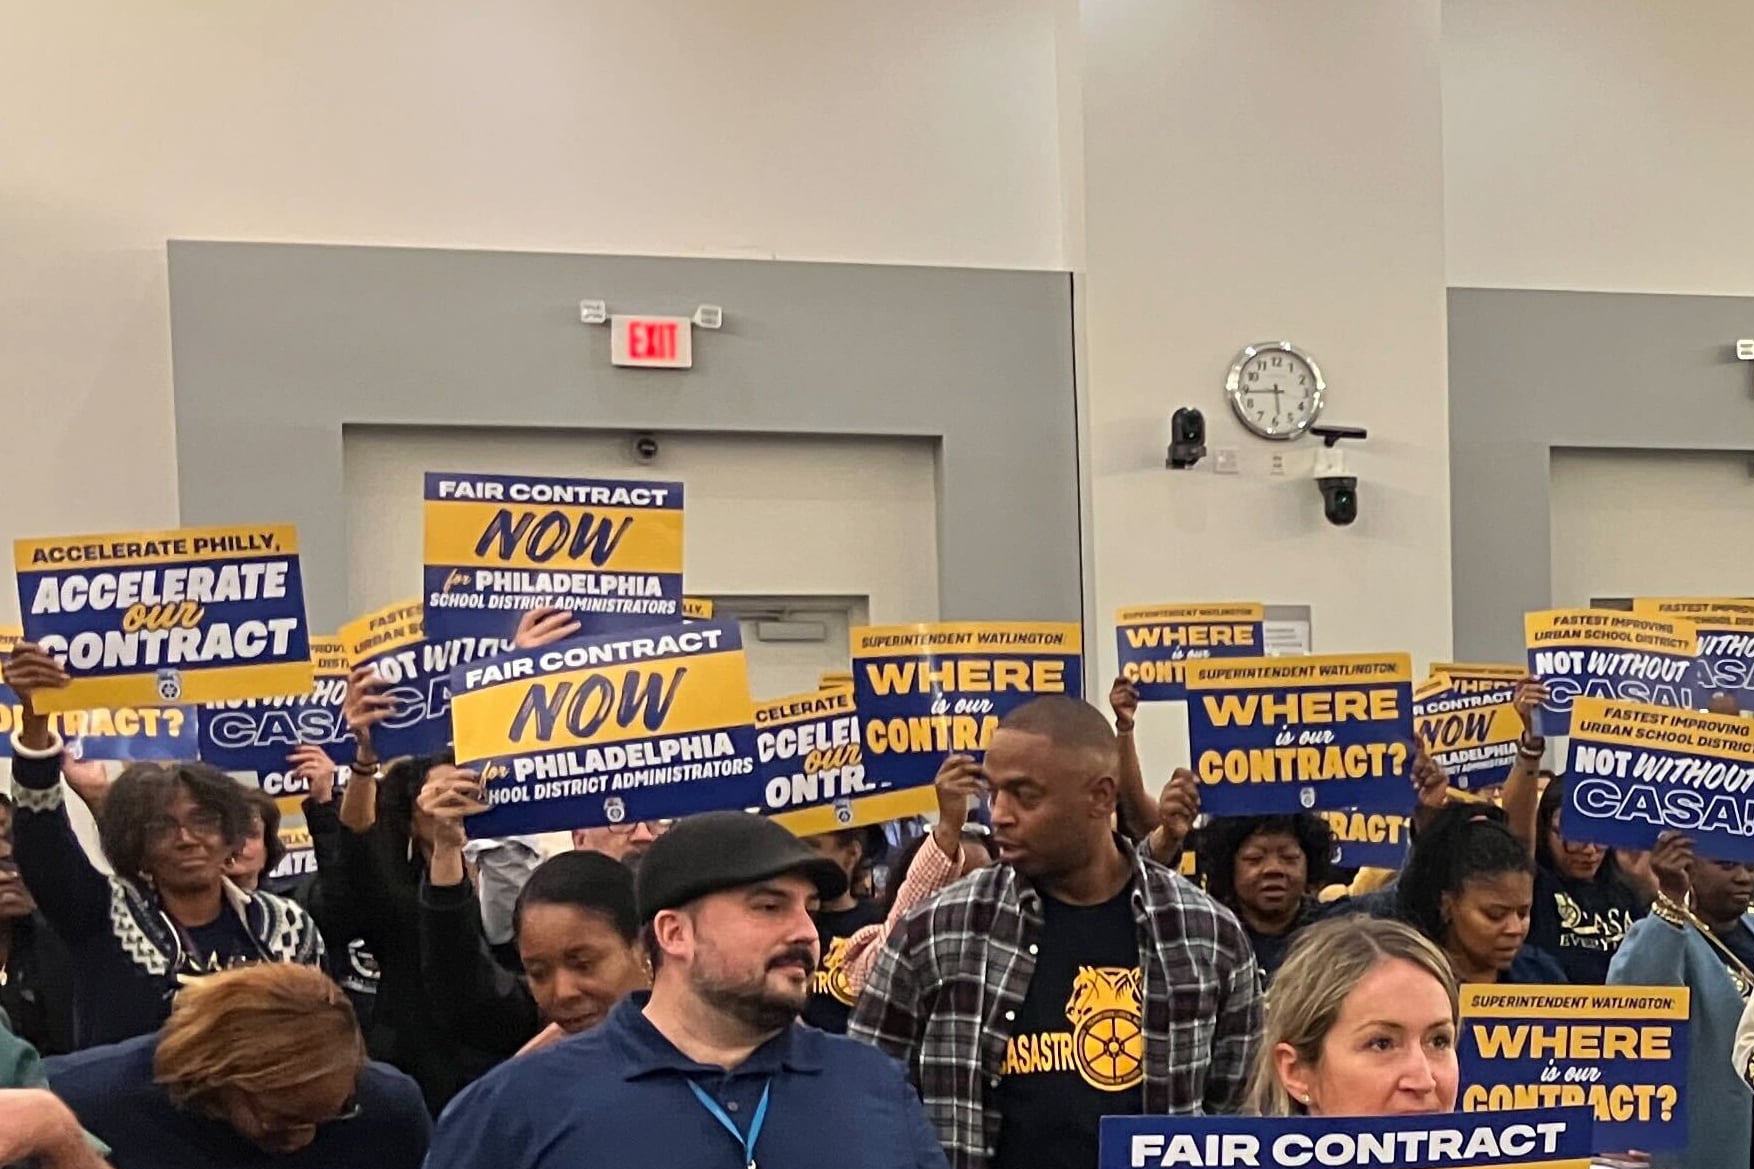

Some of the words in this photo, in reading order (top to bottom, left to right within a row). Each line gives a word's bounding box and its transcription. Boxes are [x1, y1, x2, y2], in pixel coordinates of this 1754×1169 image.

[628, 321, 677, 360] EXIT
[439, 481, 503, 499] FAIR
[509, 482, 668, 506] CONTRACT
[32, 539, 188, 565] ACCELERATE
[194, 533, 280, 554] PHILLY,
[475, 509, 633, 567] NOW
[31, 561, 289, 615] ACCELERATE
[443, 569, 470, 593] for
[476, 571, 662, 597] PHILADELPHIA
[122, 599, 204, 633] our
[430, 592, 485, 608] SCHOOL
[488, 594, 552, 611] DISTRICT
[555, 596, 676, 615] ADMINISTRATORS
[1125, 624, 1254, 648] WHERE
[1535, 629, 1581, 641] URBAN
[1584, 629, 1632, 642] SCHOOL
[1553, 616, 1609, 626] FASTEST
[38, 617, 298, 670] CONTRACT
[862, 632, 973, 648] SUPERINTENDENT
[1172, 646, 1184, 660] is
[466, 658, 534, 688] FAIR
[539, 630, 722, 671] CONTRACT
[1198, 665, 1315, 681] SUPERINTENDENT
[1535, 651, 1585, 675] NOT
[1587, 651, 1690, 683] WITHOUT
[866, 660, 1065, 696] WHERE
[508, 667, 688, 743] NOW
[755, 695, 849, 723] CELERATE
[931, 692, 950, 715] is
[954, 697, 993, 714] our
[1202, 689, 1399, 727] WHERE
[1426, 691, 1512, 714] CONTRACT
[866, 715, 1001, 754] CONTRA
[1275, 724, 1295, 746] is
[1299, 728, 1335, 745] our
[1420, 710, 1496, 749] NOW
[1580, 721, 1633, 737] URBAN
[1636, 727, 1694, 745] SCHOOL
[1604, 708, 1668, 725] FASTEST
[1671, 716, 1750, 737] IMPROVING
[478, 760, 510, 799] for
[514, 732, 735, 783] PHILADELPHIA
[804, 743, 862, 775] our
[1199, 743, 1407, 785] CONTRACT?
[1575, 746, 1633, 778] NOT
[488, 788, 531, 806] HOOL
[535, 777, 609, 802] DISTRICT
[612, 757, 753, 789] ADMINISTRATORS
[1471, 994, 1588, 1009] SUPERINTENDENT
[1473, 1025, 1673, 1060] WHERE
[1540, 1058, 1561, 1082] is
[1564, 1065, 1602, 1083] our
[1463, 1084, 1678, 1122] CONTRACT?
[1130, 1133, 1260, 1168] FAIR
[1272, 1122, 1567, 1167] CONTRACT
